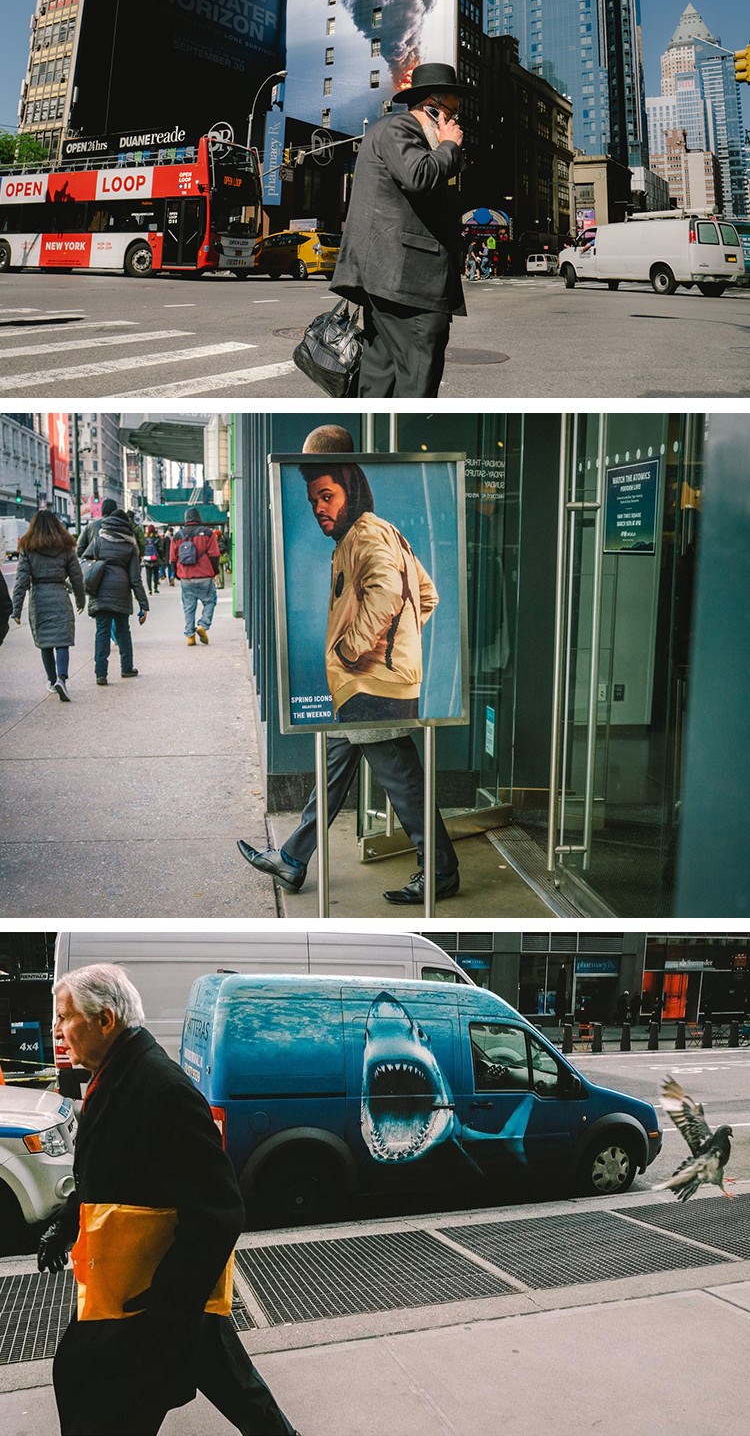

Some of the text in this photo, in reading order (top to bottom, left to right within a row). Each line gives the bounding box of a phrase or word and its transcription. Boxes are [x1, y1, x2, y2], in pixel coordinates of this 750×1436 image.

[172, 39, 231, 67] SEPTEMBER
[233, 61, 245, 72] 30
[66, 142, 88, 154] OPEN
[264, 137, 283, 197] pharmacy
[5, 175, 147, 197] OPEN LOOP
[45, 241, 64, 250] NEW
[64, 241, 86, 250] YORK
[612, 475, 625, 485] WATCH
[625, 474, 633, 482] THE
[20, 1042, 39, 1051] 4x4
